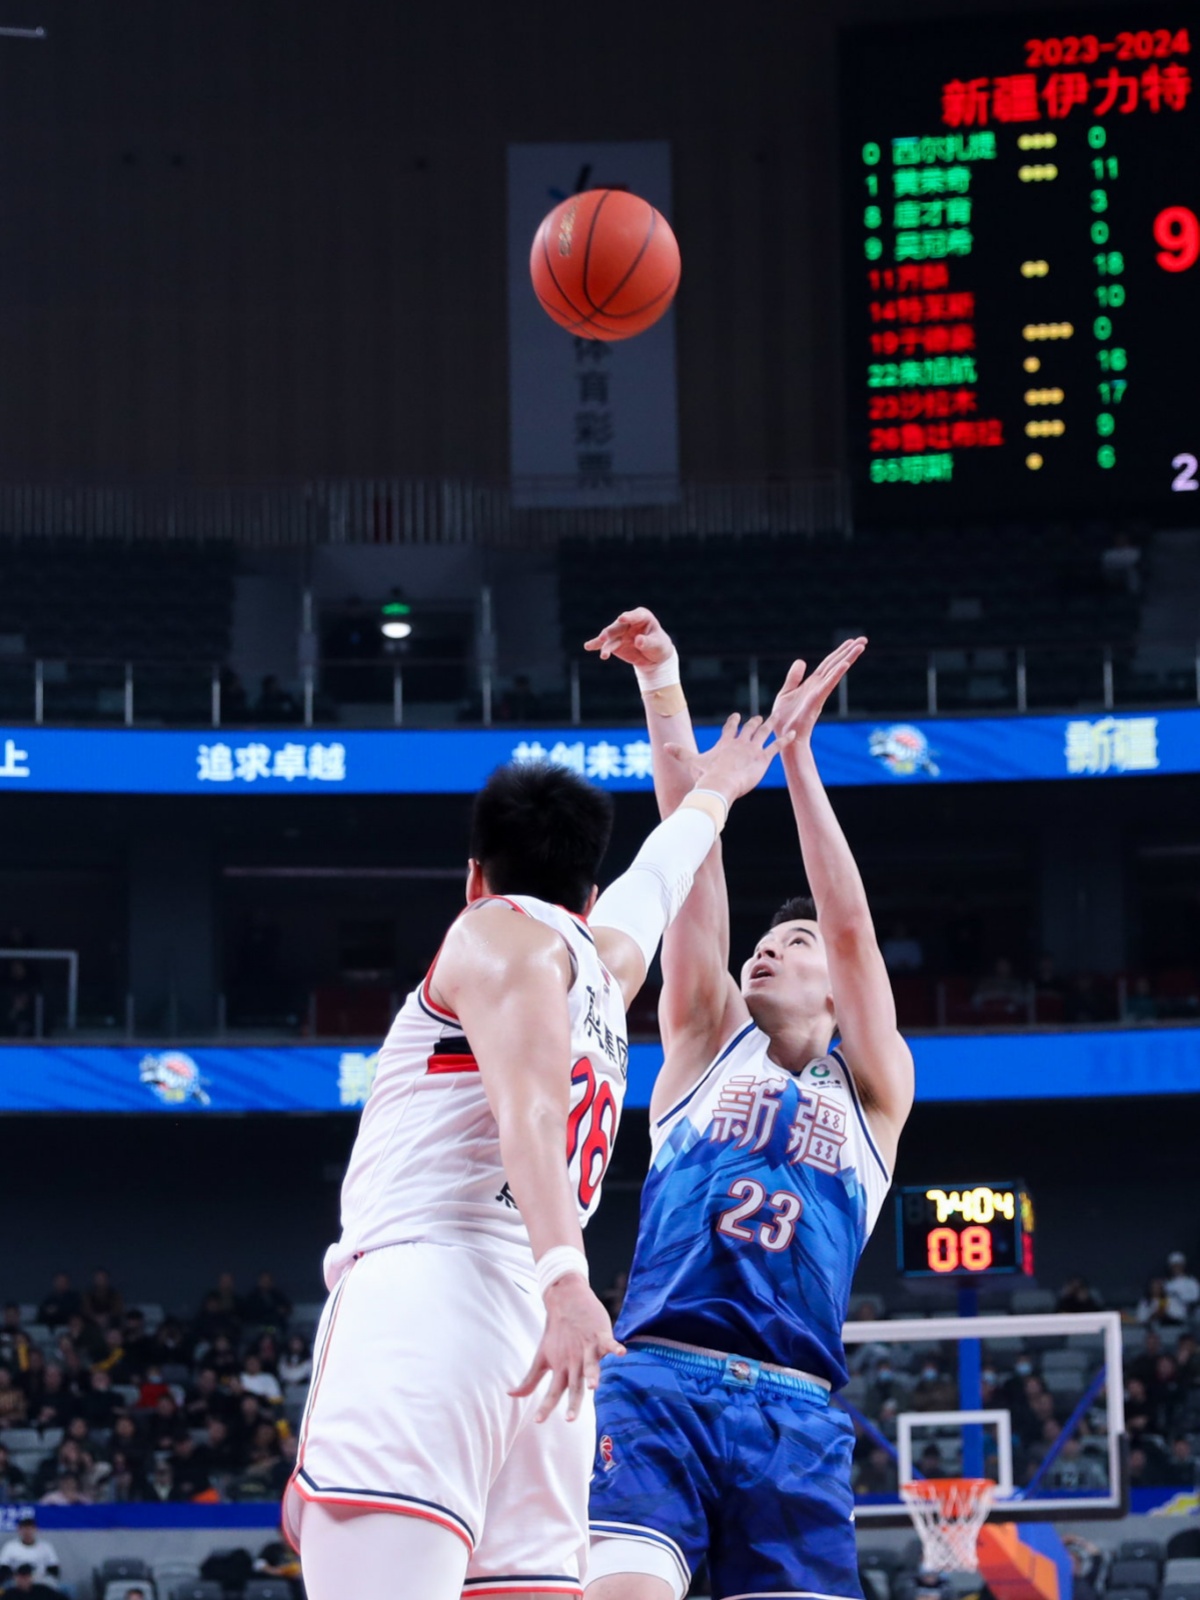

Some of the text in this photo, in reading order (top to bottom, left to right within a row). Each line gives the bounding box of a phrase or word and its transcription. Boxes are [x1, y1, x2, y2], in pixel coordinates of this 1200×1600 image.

[1025, 28, 1191, 68] 2023-2024
[942, 64, 1192, 127] 新疆伊力特
[863, 142, 881, 165] 0
[1088, 126, 1107, 149] 0
[866, 174, 878, 196] 1
[1093, 157, 1119, 180] 11
[1091, 190, 1108, 213] 3
[1091, 221, 1109, 245] 0
[1153, 204, 1200, 273] 9
[1096, 284, 1127, 308] 10
[1093, 316, 1112, 341] 0
[1098, 379, 1129, 402] 17
[1171, 452, 1199, 492] 2
[0, 739, 30, 777] 上
[196, 742, 346, 782] 追求卓越
[710, 1074, 848, 1176] 新疆
[715, 1178, 803, 1253] 23
[927, 1225, 993, 1273] 08
